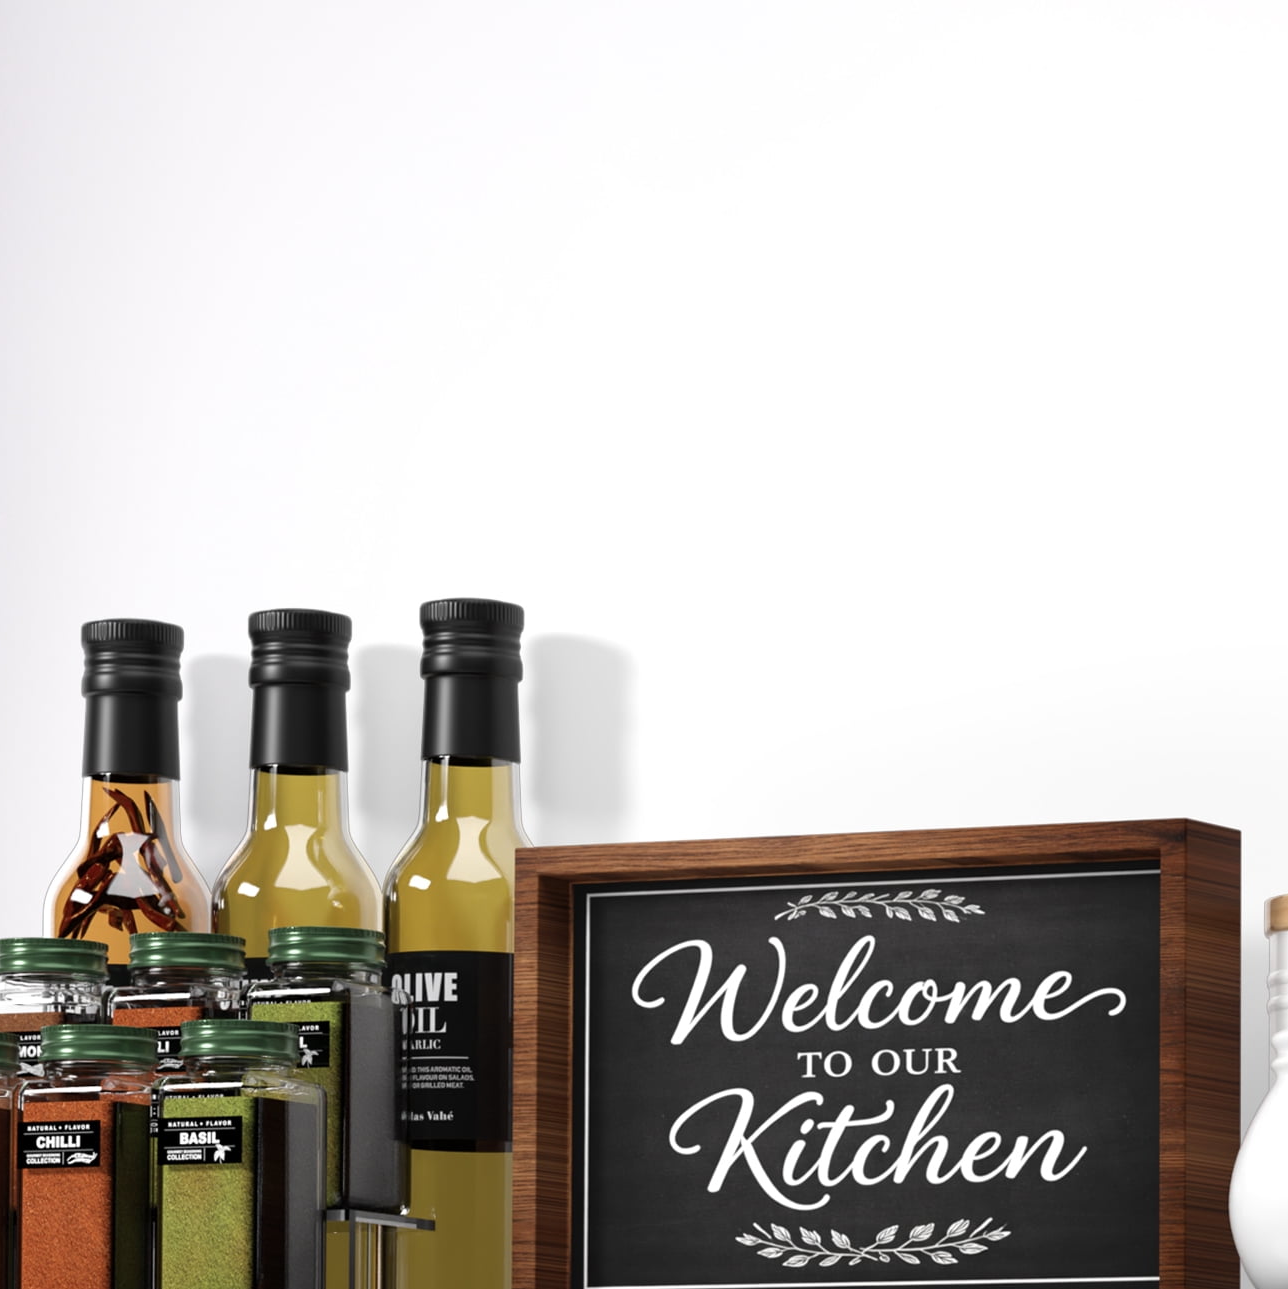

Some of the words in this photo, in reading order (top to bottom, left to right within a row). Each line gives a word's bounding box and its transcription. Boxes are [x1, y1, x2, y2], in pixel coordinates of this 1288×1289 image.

[630, 934, 1127, 1045] Welcome
[797, 1050, 853, 1078] TO
[871, 1047, 962, 1076] OUR
[427, 1110, 454, 1120] Vahé
[35, 1135, 81, 1149] CHILLI
[179, 1131, 221, 1145] BASIL
[668, 1083, 1088, 1211] Kitchen
